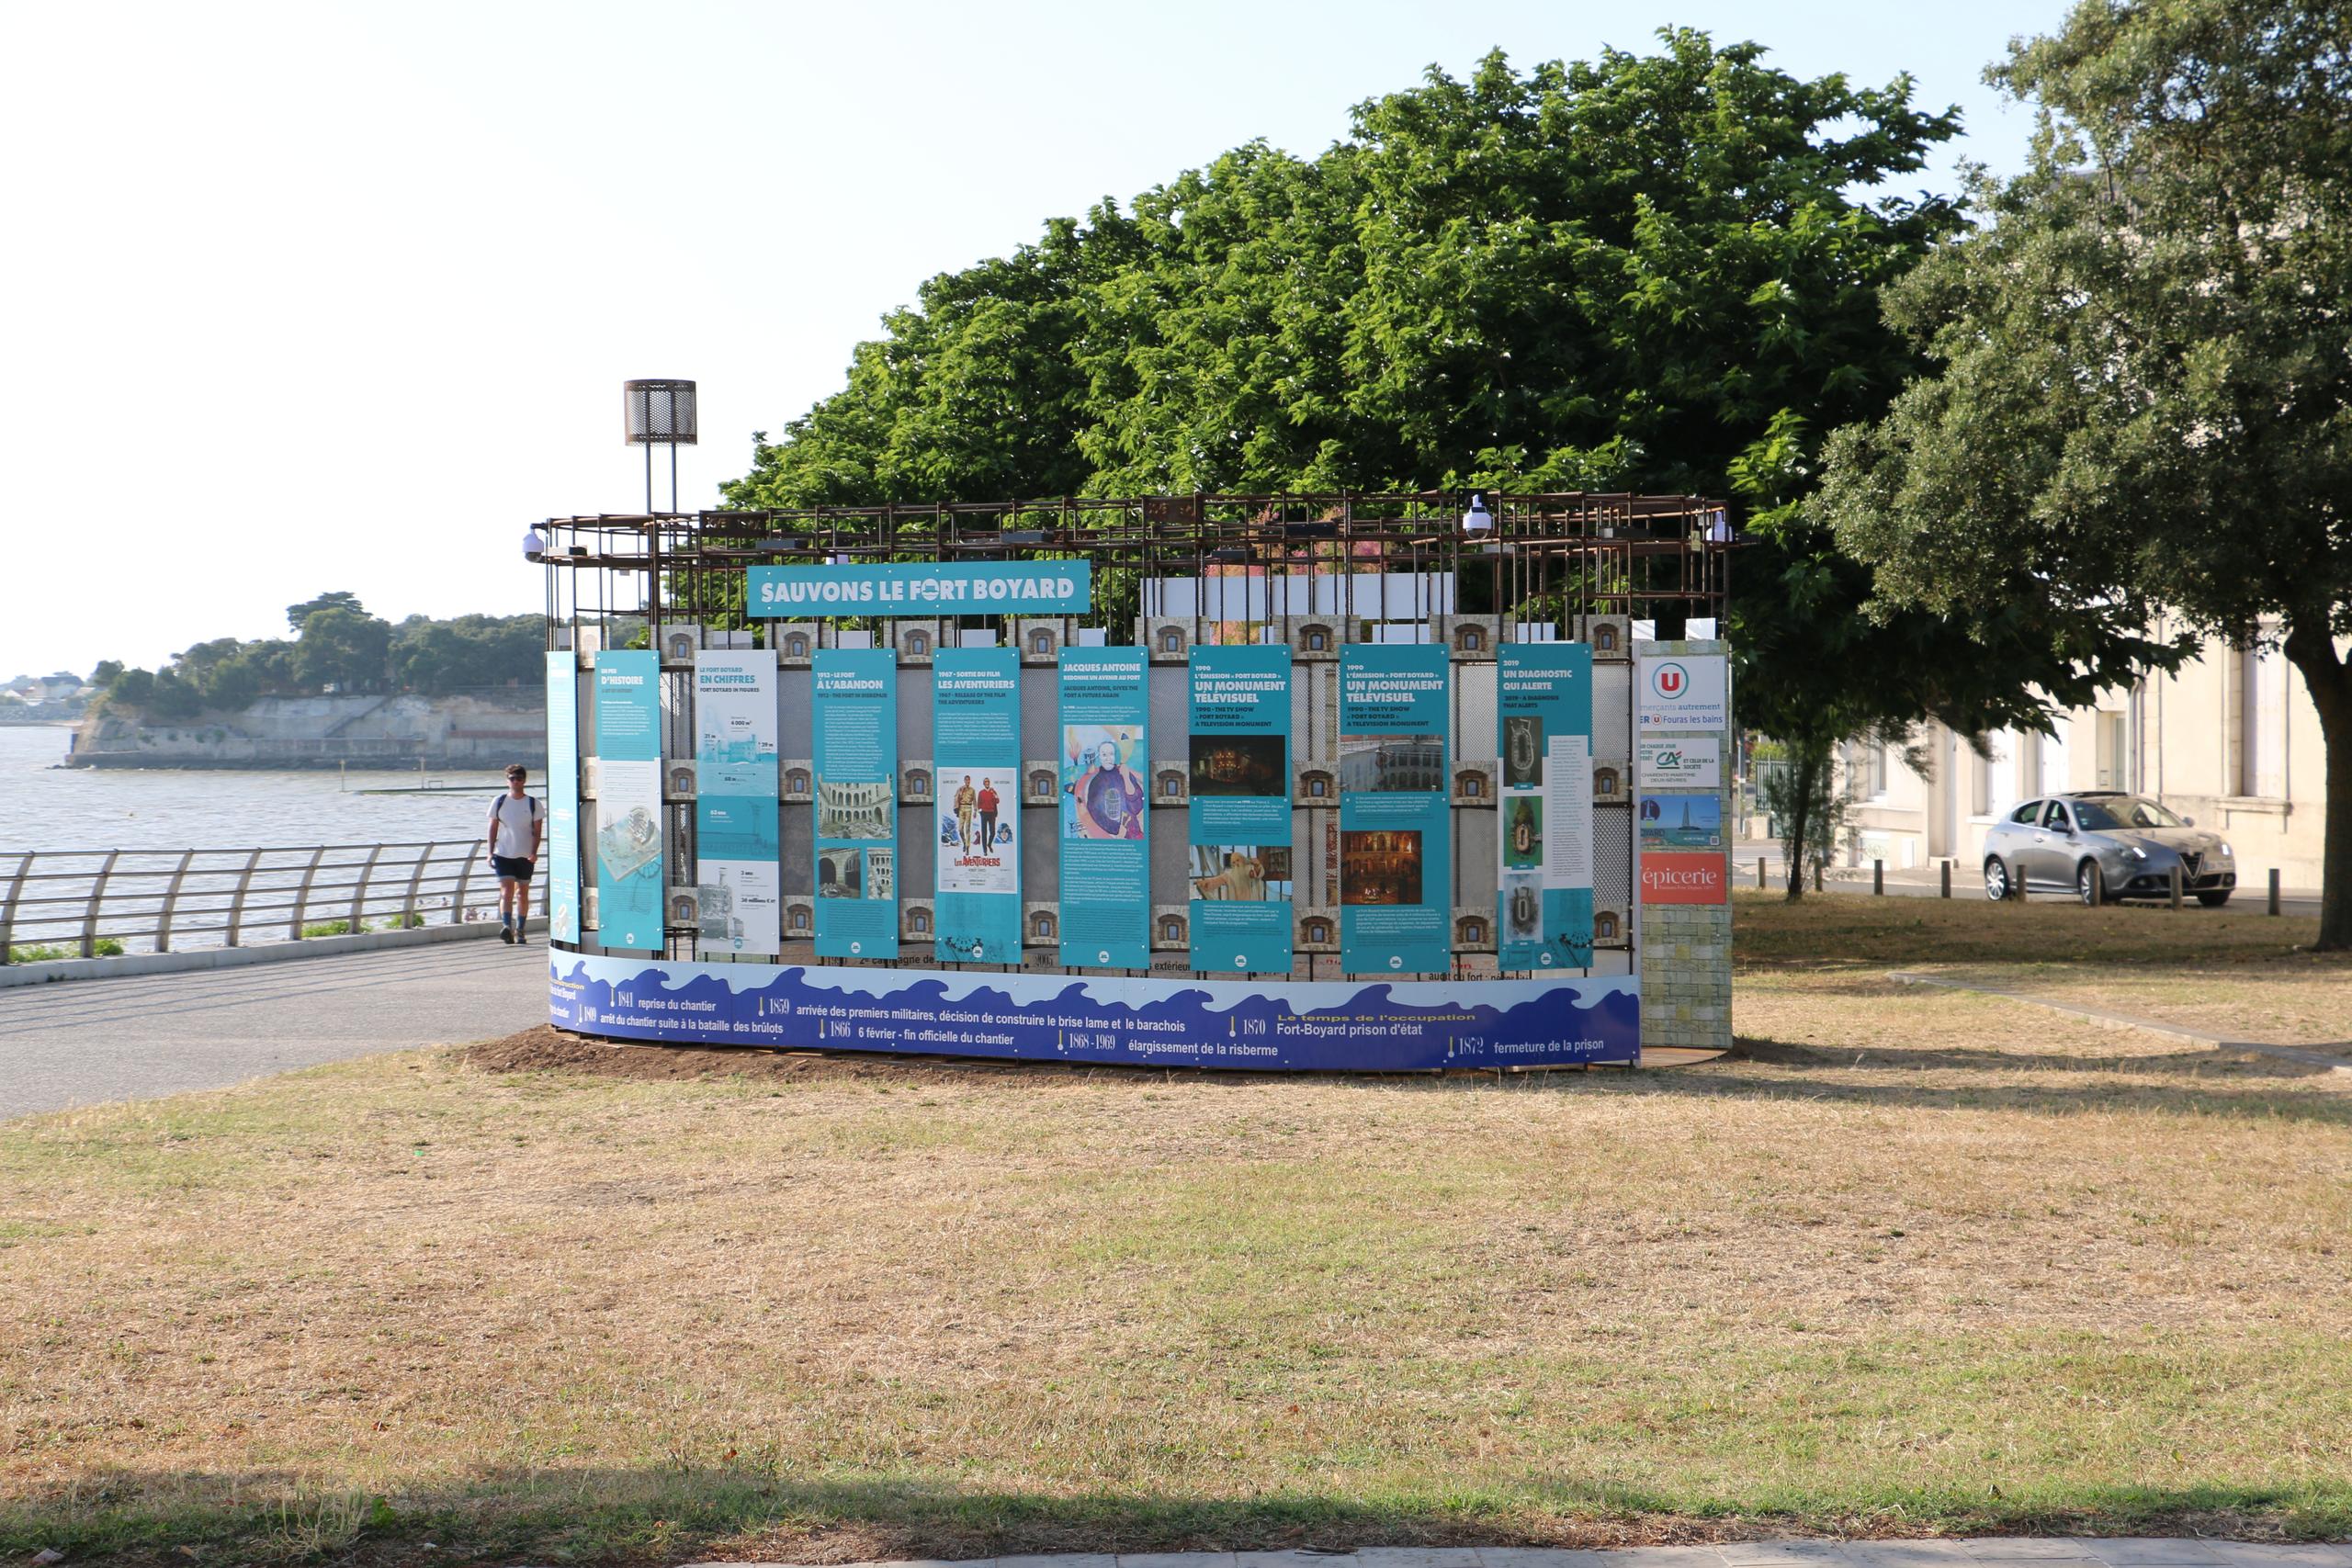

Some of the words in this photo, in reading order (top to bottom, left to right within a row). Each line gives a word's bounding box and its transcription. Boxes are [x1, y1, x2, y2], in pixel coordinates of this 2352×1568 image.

[761, 581, 872, 603] SAUVONS
[879, 581, 903, 601] LE
[910, 579, 967, 601] FORT
[973, 578, 1075, 600] BOYARD
[1063, 663, 1101, 671] JACQUES
[1102, 663, 1140, 671] ANTOINE
[700, 675, 712, 684] EN
[714, 675, 755, 684] CHIFFRES
[1503, 670, 1517, 678] UN
[1518, 670, 1572, 678] DIAGNOSTIC
[601, 676, 643, 685] D'HISTOIRE
[817, 678, 824, 689] À
[825, 680, 883, 689] L'ABANDON
[938, 681, 953, 689] LES
[954, 681, 1014, 689] AVENTURIERS
[1195, 681, 1212, 691] UN
[1215, 681, 1286, 691] MONUMENT
[1346, 681, 1365, 690] UN
[1367, 681, 1443, 690] MONUMENT
[1661, 672, 1679, 691] U
[1194, 690, 1259, 703] TÉLÉVISUEL
[1346, 690, 1415, 702] TÉLÉVISUEL
[1702, 715, 1724, 724] bains
[1467, 972, 1482, 981] fort
[617, 991, 633, 1008] 1841
[638, 998, 666, 1010] reprise
[668, 998, 679, 1010] du
[681, 999, 716, 1011] chantier
[769, 998, 789, 1014] 1859
[797, 1005, 828, 1016] arrivée
[830, 1005, 847, 1017] des
[849, 1007, 889, 1020] premiers
[891, 1008, 937, 1023] militaires,
[939, 1010, 979, 1023] décision
[981, 1011, 993, 1024] de
[996, 1013, 1045, 1026] construire
[1047, 1014, 1056, 1026] le
[1058, 1015, 1082, 1028] brise
[1085, 1016, 1109, 1029] lame
[1112, 1019, 1121, 1030] et
[1125, 1018, 1135, 1030] le
[1136, 1019, 1186, 1032] barachois
[1380, 1014, 1476, 1022] l'occupation
[600, 1013, 616, 1024] arrêt
[616, 1013, 626, 1025] du
[627, 1015, 657, 1028] chantier
[658, 1018, 679, 1029] suite
[681, 1018, 686, 1029] à
[688, 1019, 696, 1030] la
[698, 1020, 729, 1032] bataille
[733, 1021, 750, 1032] des
[752, 1021, 784, 1033] brûlots
[831, 1021, 851, 1037] 1866
[858, 1027, 865, 1038] 6
[866, 1027, 896, 1039] février
[904, 1028, 916, 1041] fin
[918, 1029, 957, 1043] officielle
[960, 1031, 972, 1043] du
[975, 1032, 1014, 1045] chantier
[1243, 1019, 1266, 1035] 1870
[1276, 1022, 1347, 1038] Fort-Boyard
[1349, 1023, 1387, 1039] prison
[1390, 1022, 1423, 1036] d'état
[1128, 1039, 1198, 1055] élargissement
[1201, 1042, 1214, 1055] de
[1216, 1042, 1227, 1055] la
[1229, 1043, 1278, 1056] risberme
[1459, 1037, 1484, 1055] 1872
[1494, 1041, 1545, 1055] fermeture
[1548, 1041, 1561, 1052] de
[1563, 1040, 1573, 1052] la
[1575, 1039, 1604, 1053] prison
